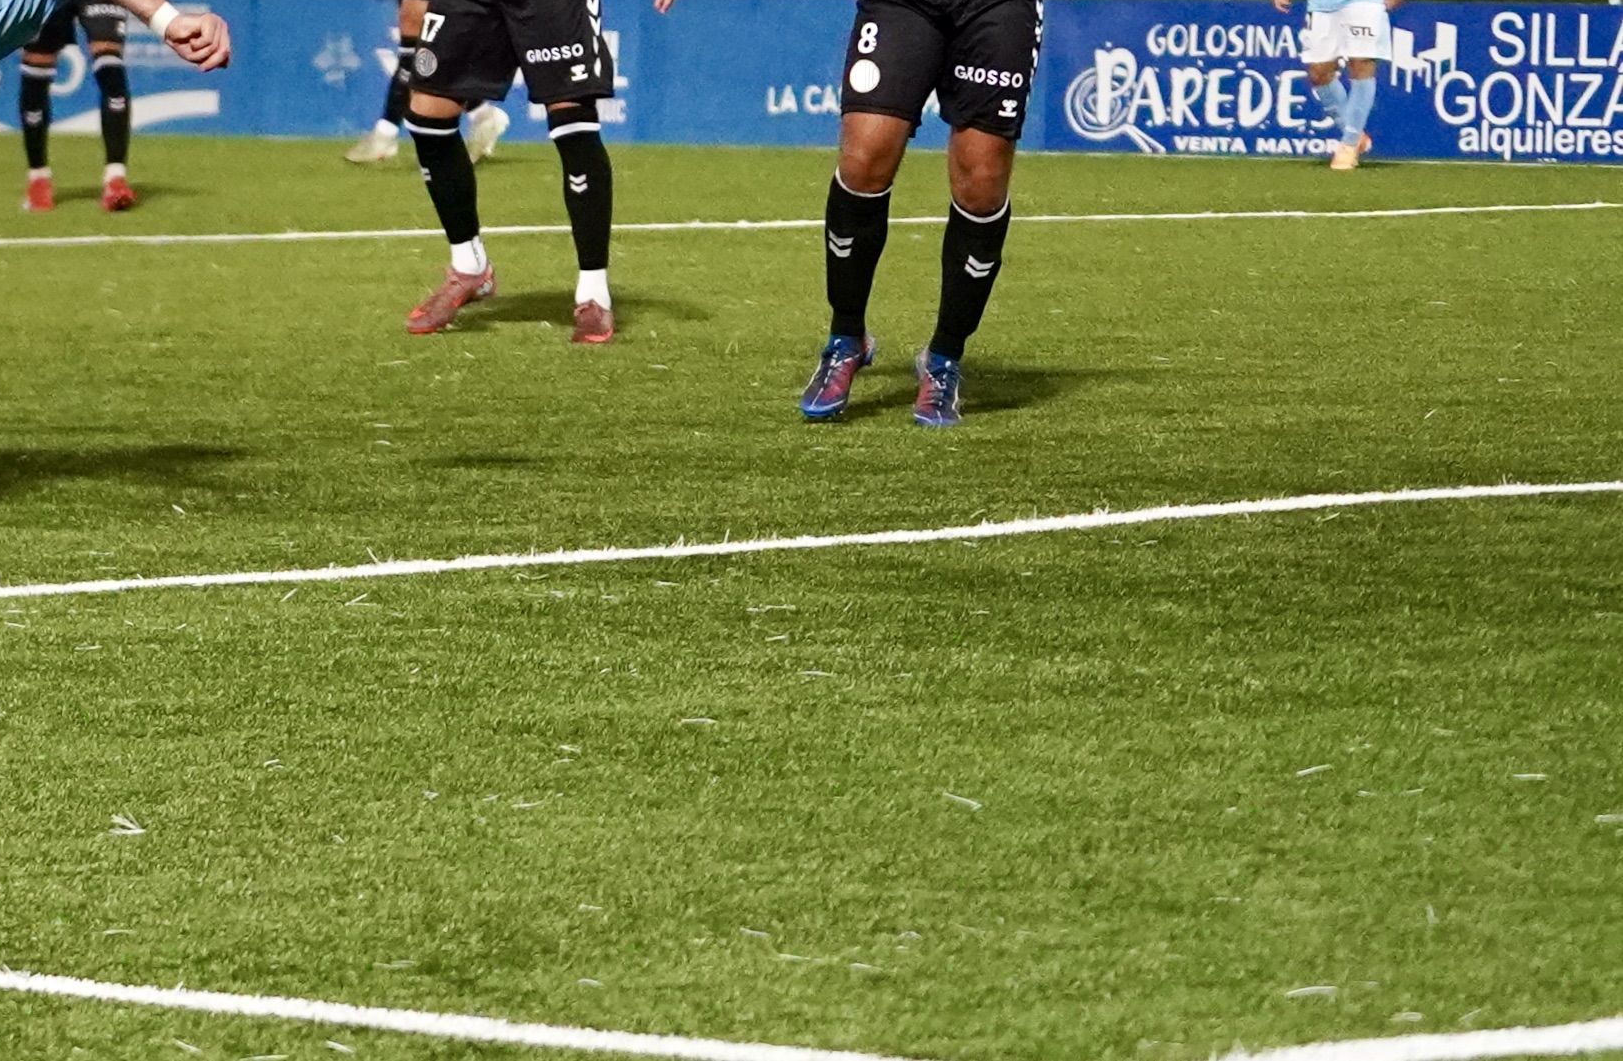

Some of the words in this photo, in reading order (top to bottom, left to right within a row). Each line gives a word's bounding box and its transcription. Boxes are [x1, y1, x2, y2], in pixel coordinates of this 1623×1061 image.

[421, 12, 446, 43] 17
[858, 22, 878, 54] 8
[1146, 23, 1298, 58] GOLOSINA
[526, 43, 585, 64] GROSSO
[954, 65, 1024, 89] GROSSO
[767, 84, 798, 115] LA
[1173, 135, 1247, 154] VENTA
